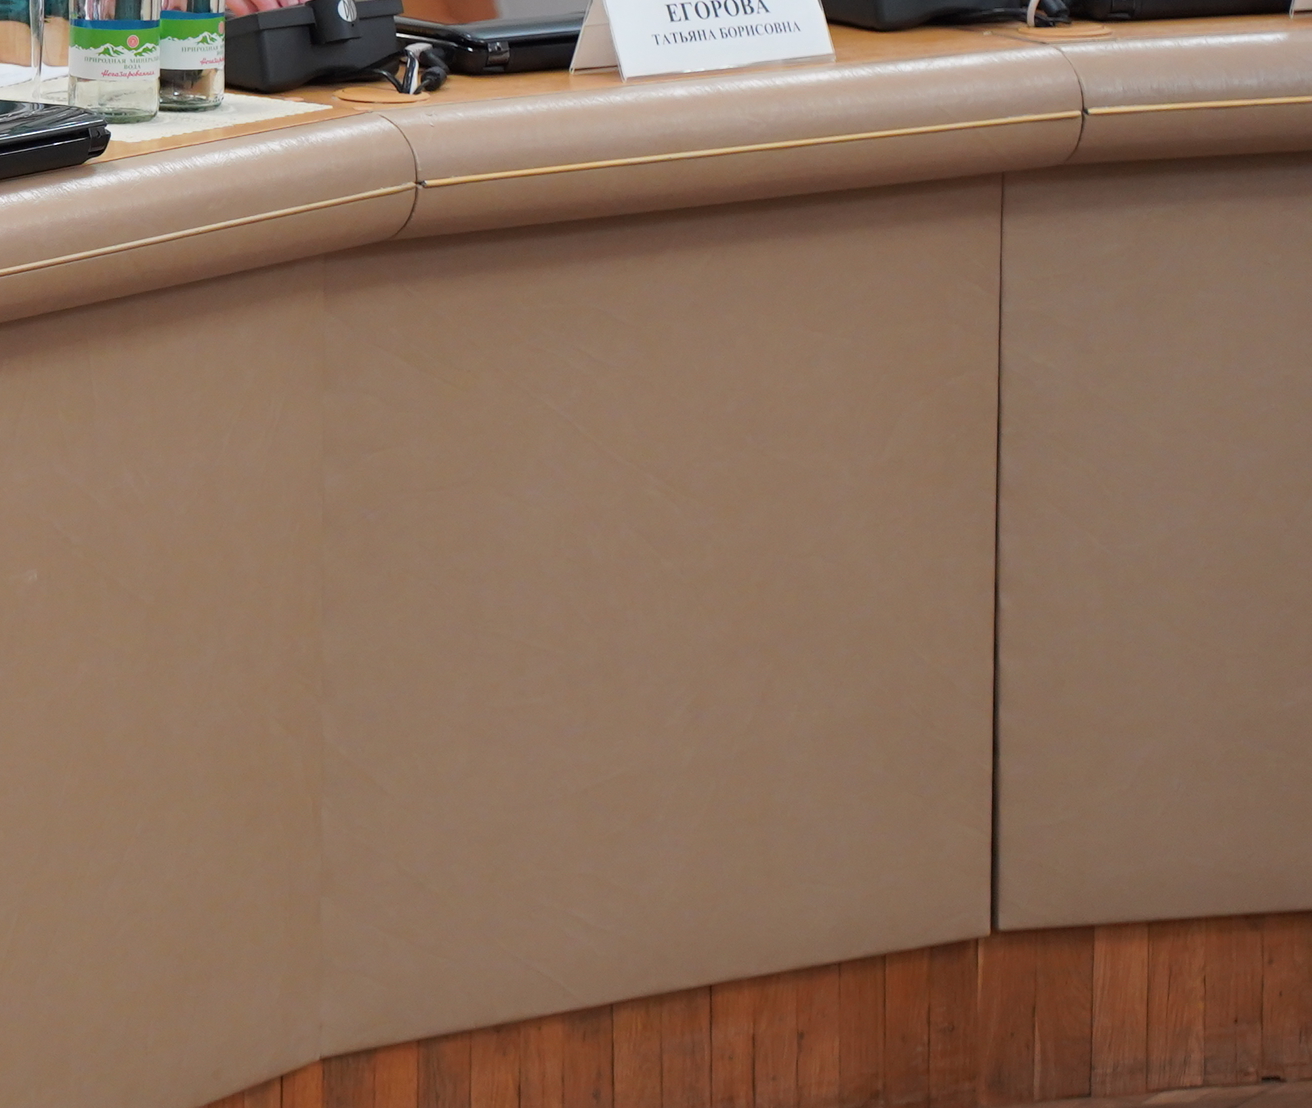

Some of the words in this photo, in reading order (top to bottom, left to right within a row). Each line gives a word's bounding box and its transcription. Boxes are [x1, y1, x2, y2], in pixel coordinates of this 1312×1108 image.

[652, 29, 717, 46] ТАТЬЯНА
[719, 20, 802, 40] БОРИСОВНА
[84, 56, 127, 64] ПРИРОДНАЯ
